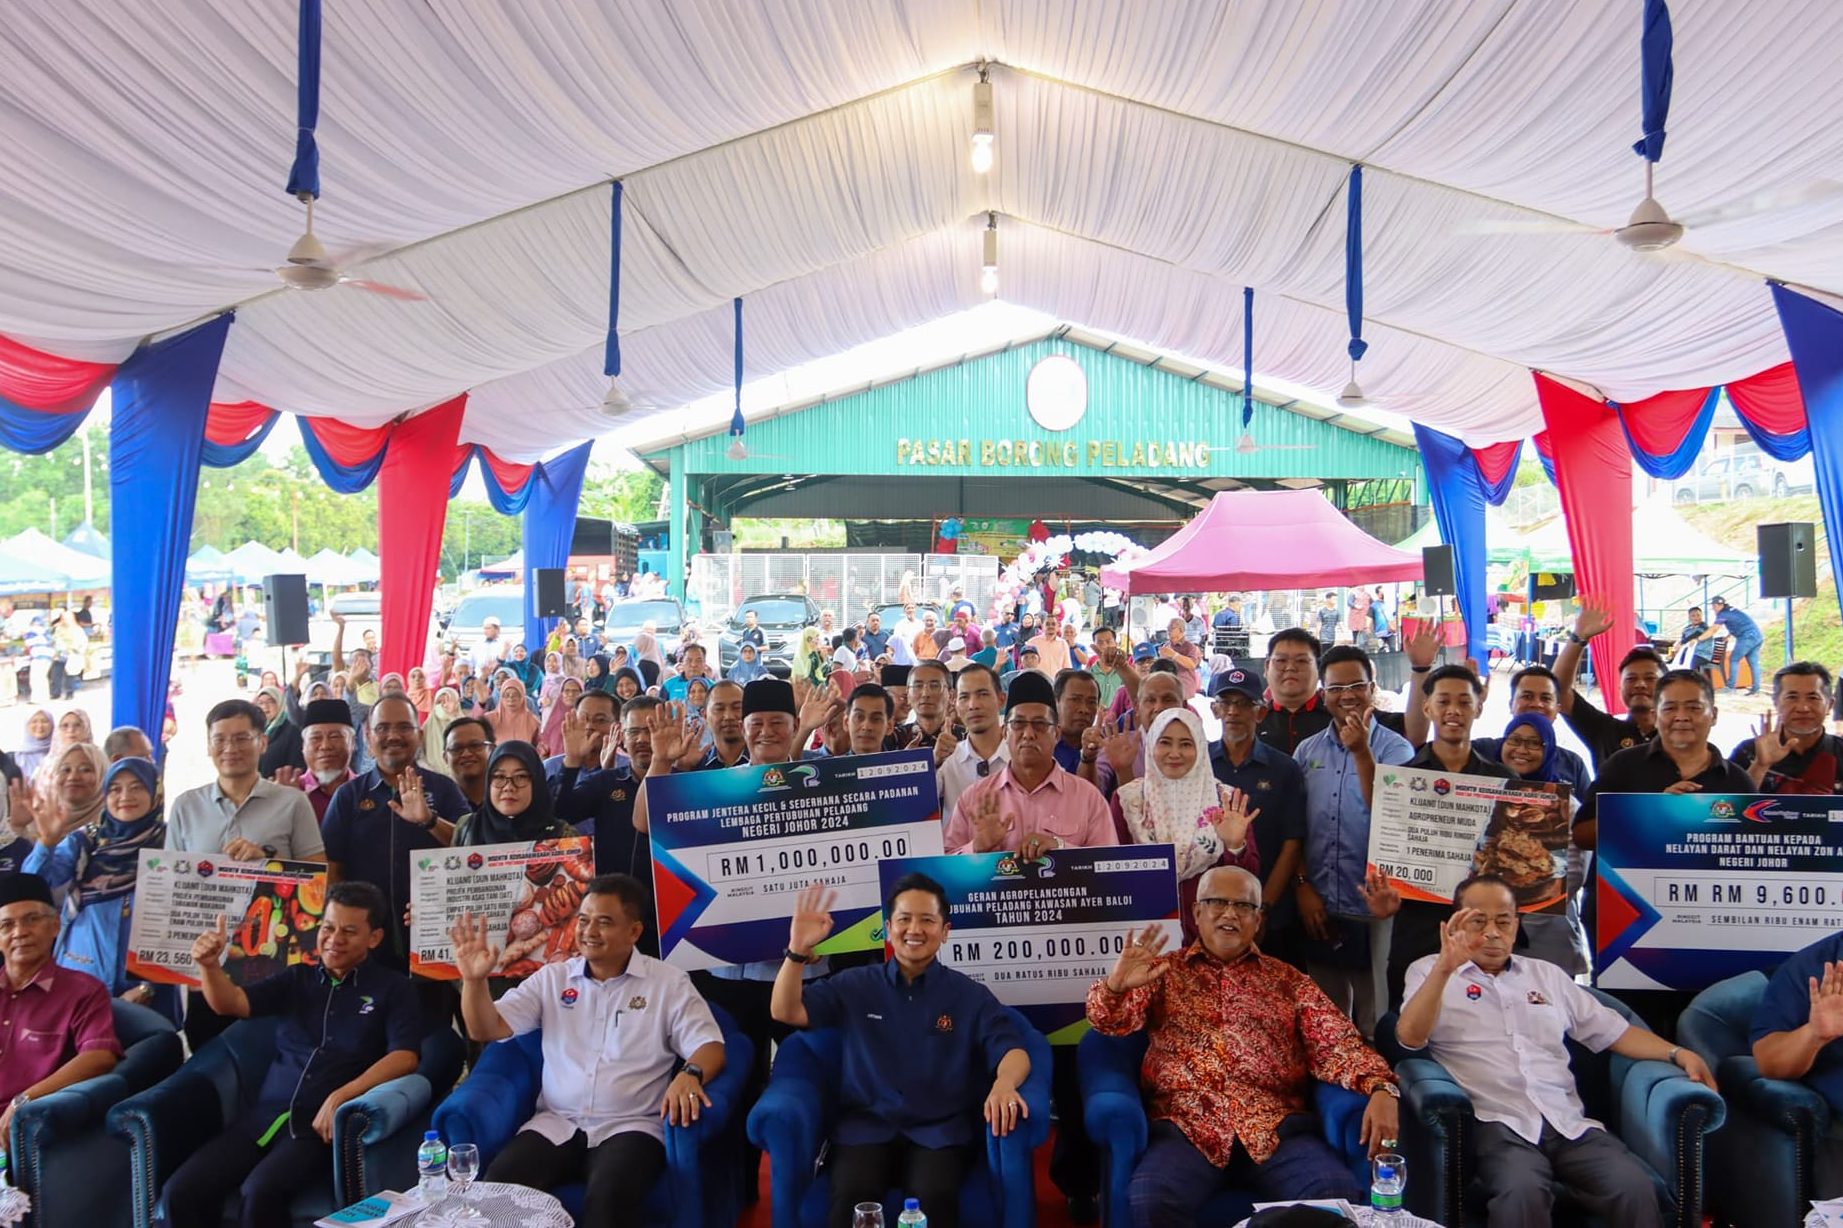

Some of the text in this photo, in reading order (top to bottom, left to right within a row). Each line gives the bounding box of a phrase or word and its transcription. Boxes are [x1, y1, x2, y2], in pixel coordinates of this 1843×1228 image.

[897, 438, 1211, 468] PASAR BORONG PELADANG
[667, 785, 919, 823] PROGRAM JENTERA KECIL & SEDERHANA SECARA PADANAN
[720, 803, 869, 828] LEMBAGA PERTUBUHAN PELADANG
[1408, 812, 1455, 825] AGROPRENEUR
[1457, 816, 1476, 827] MUDA
[742, 815, 849, 839] NEGERI JOHOR 2024
[1686, 833, 1821, 845] PROGRAM BANTUAN KEPADA
[1411, 847, 1446, 859] PENERIMA
[1447, 851, 1472, 862] SAHAJA
[1666, 844, 1708, 854] NELAYAN
[1711, 844, 1742, 854] DARAT
[1744, 845, 1763, 855] DAN
[1767, 846, 1810, 856] NELAYAN
[1719, 858, 1788, 868] NEGERI JOHOR
[763, 883, 785, 893] SATU
[789, 879, 810, 890] JUTA
[968, 887, 1087, 902] GERAN AGROPELANCONGAN
[1669, 883, 1843, 907] RM RM 9,600.
[986, 900, 1032, 912] PELADANG
[1035, 898, 1077, 910] KAWASAN
[1080, 896, 1103, 907] AYER
[1106, 895, 1132, 906] BALOI
[995, 909, 1063, 924] TAHUN 2024
[1711, 915, 1760, 925] SEMBILAN
[1765, 916, 1787, 925] RIBU
[1792, 917, 1818, 926] ENAM
[139, 951, 154, 962] RM
[421, 949, 436, 961] RM
[953, 943, 980, 962] RM
[994, 970, 1013, 981] DUA
[1015, 968, 1044, 980] RATUS
[1047, 967, 1069, 979] RIBU
[1072, 966, 1107, 978] SAHAJA
